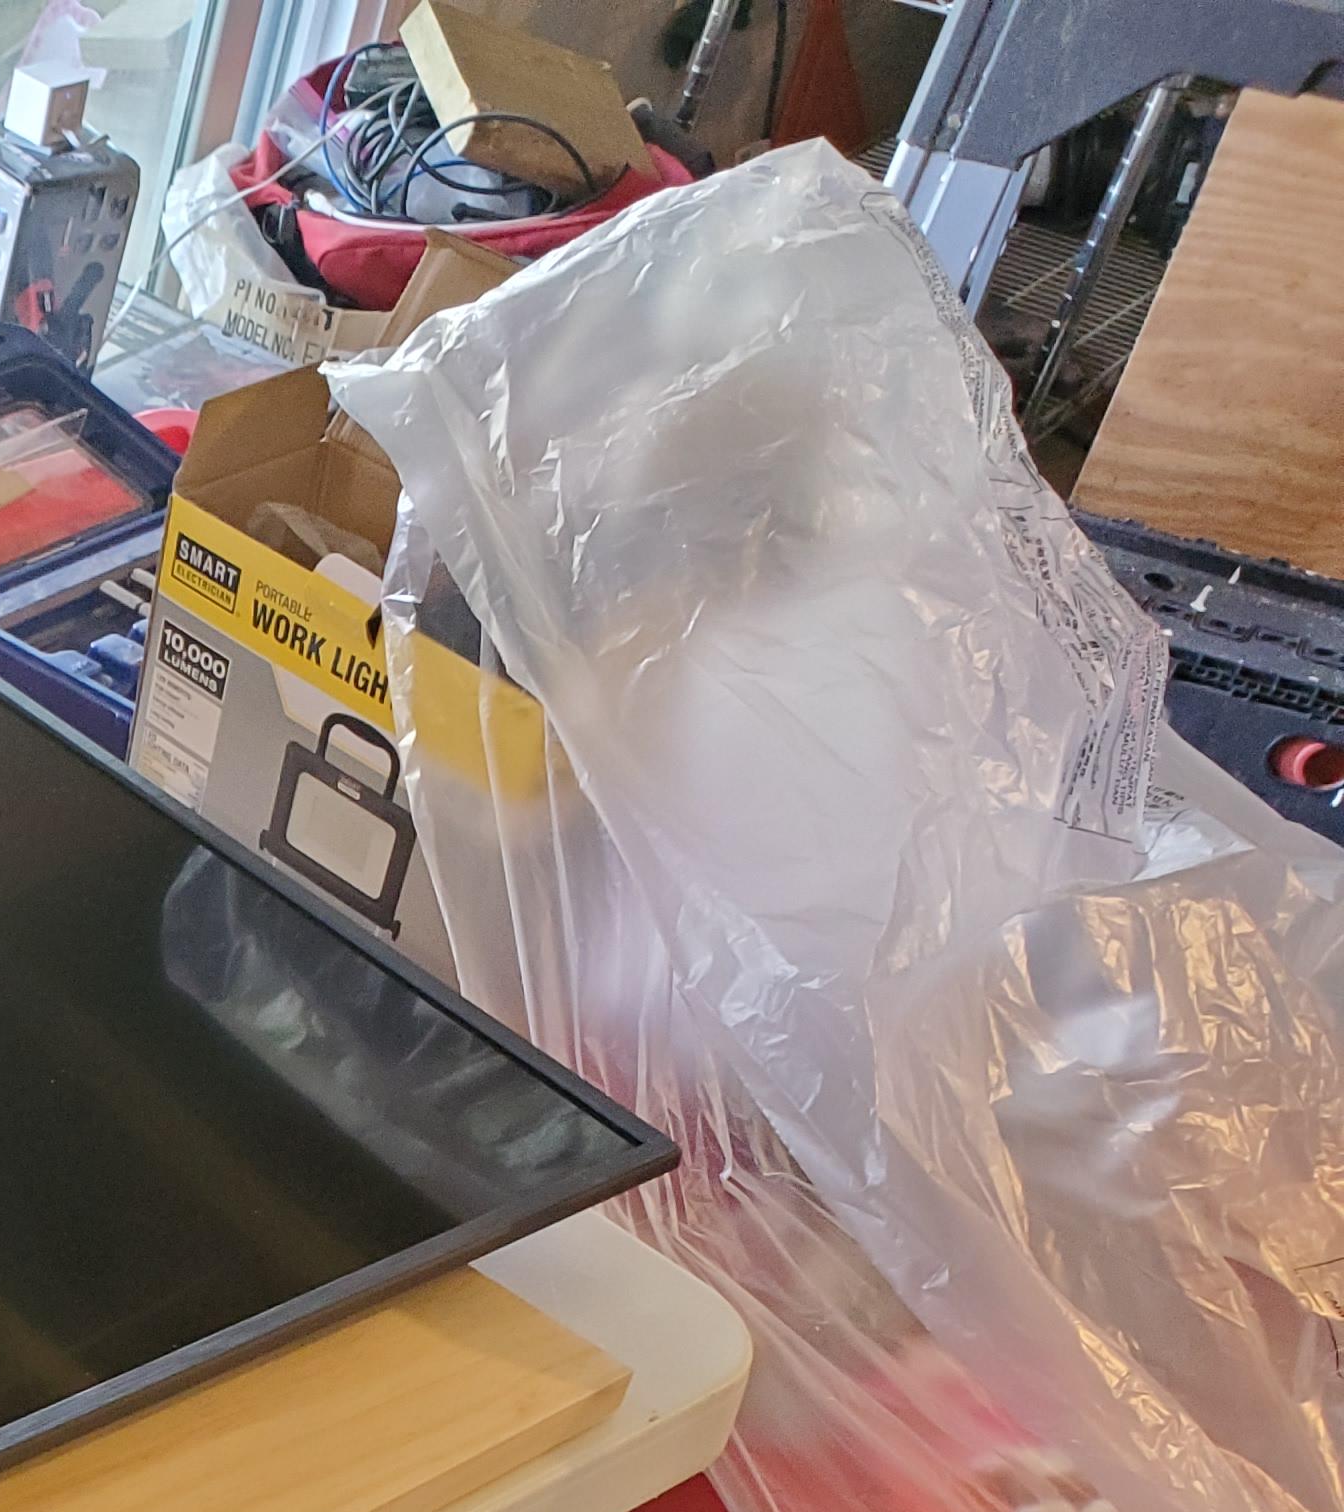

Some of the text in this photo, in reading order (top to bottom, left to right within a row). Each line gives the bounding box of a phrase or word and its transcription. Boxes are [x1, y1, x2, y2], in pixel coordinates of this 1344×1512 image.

[222, 309, 269, 349] MODEL
[175, 564, 233, 606] ELECTRICIAN
[178, 539, 239, 588] SMART
[255, 580, 313, 622] PORTABLE
[163, 628, 226, 680] 10,000
[163, 650, 218, 693] LUMENS
[252, 599, 394, 711] WORK LIGH
